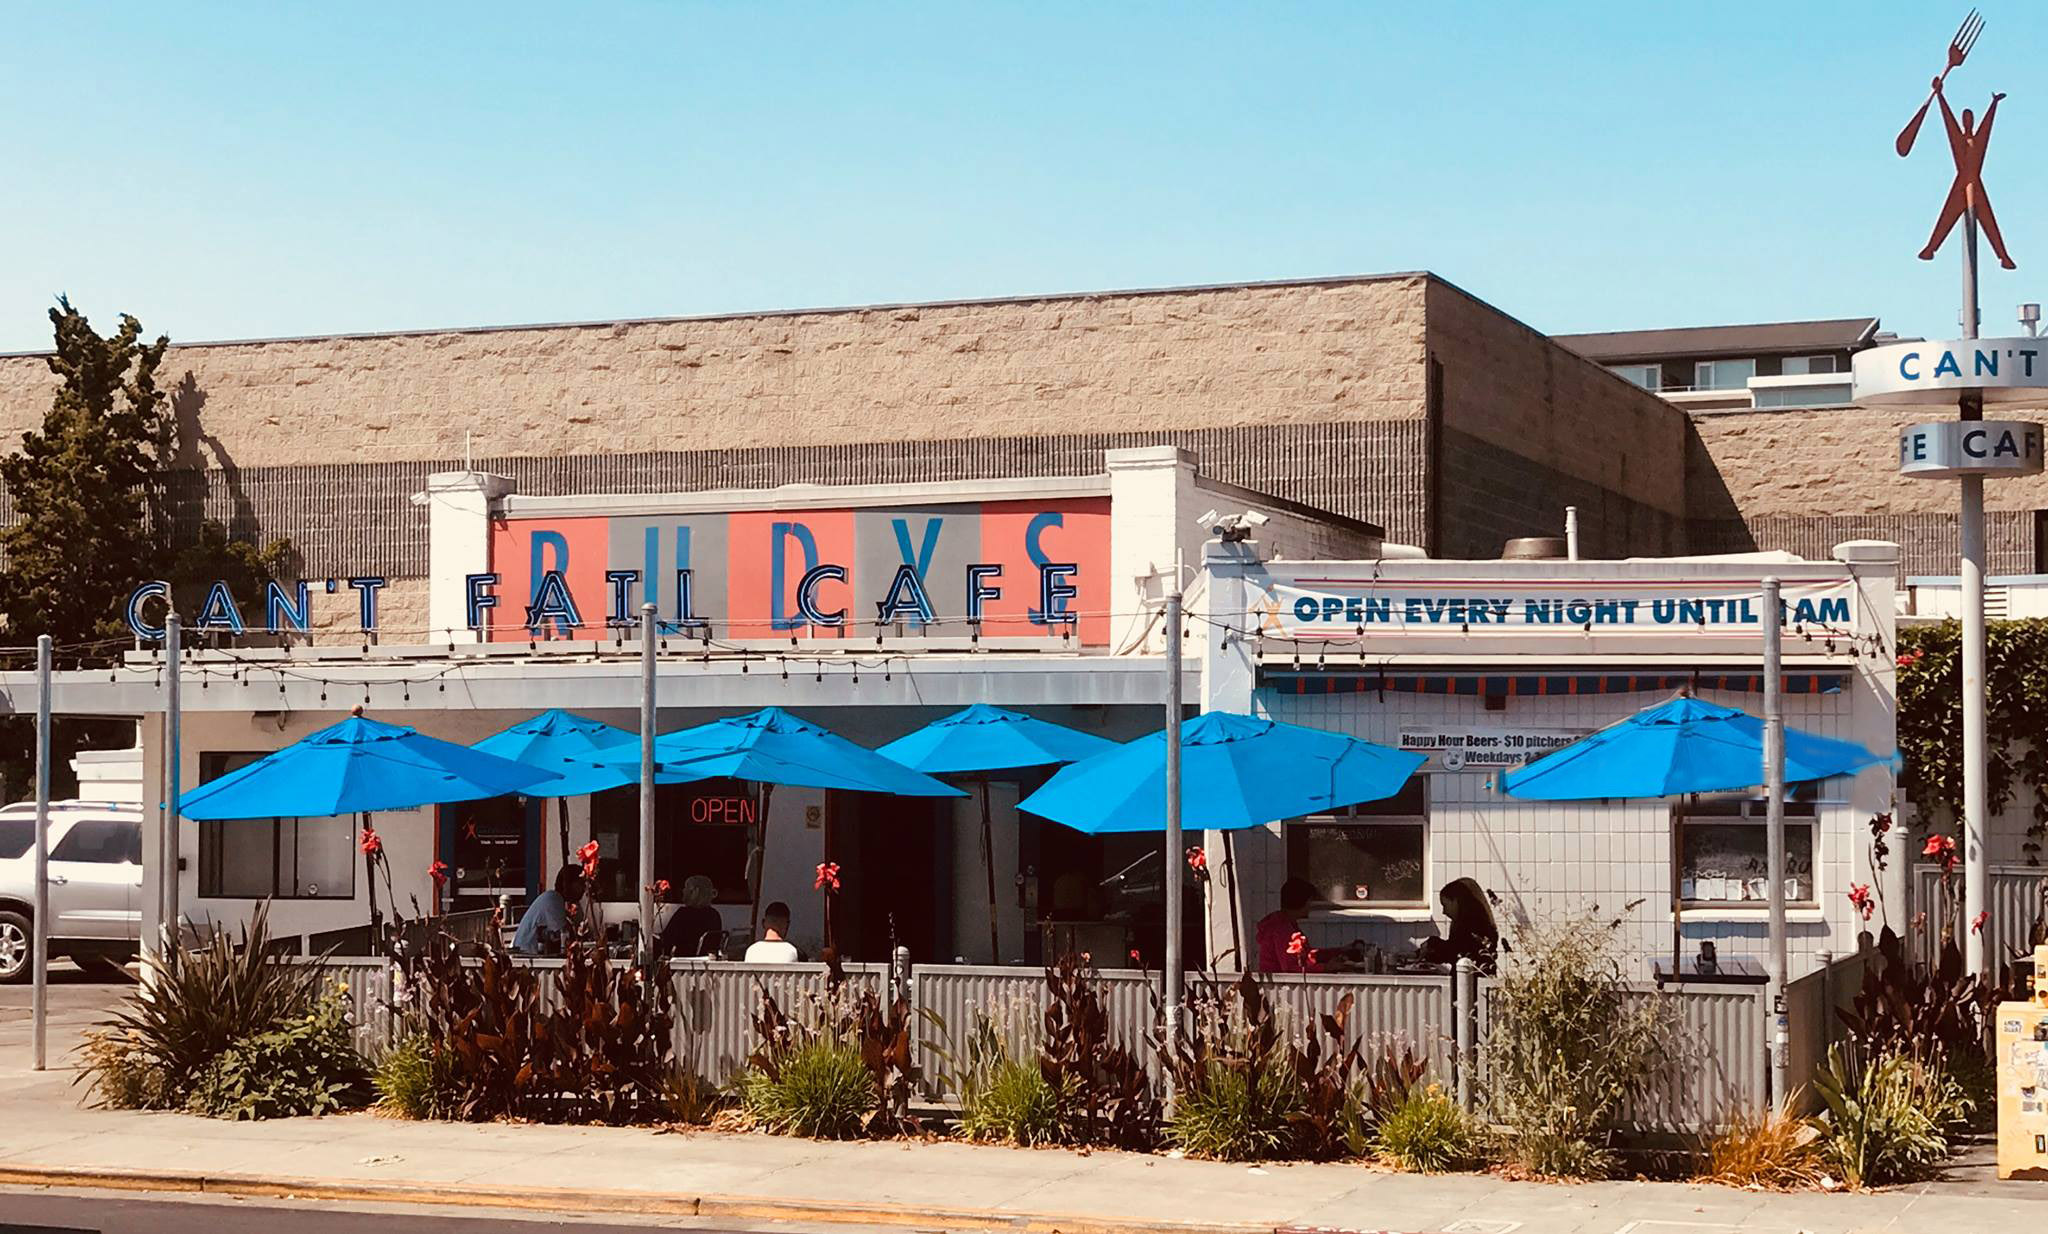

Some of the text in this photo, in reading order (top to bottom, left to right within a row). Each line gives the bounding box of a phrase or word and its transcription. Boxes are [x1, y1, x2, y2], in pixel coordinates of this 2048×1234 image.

[1899, 349, 2038, 381] CAN'T
[124, 563, 1078, 642] CAN'T FAIL CAFE
[1294, 596, 1390, 622] OPEN
[1405, 597, 1514, 624] EVERY
[1525, 598, 1640, 624] NIGHT
[1652, 597, 1758, 624] UNTIL
[1402, 734, 1436, 748] Happy
[1438, 734, 1465, 747] Hour
[1504, 735, 1524, 747] $10
[1465, 751, 1522, 764] Weekdays
[691, 798, 756, 823] OPEN
